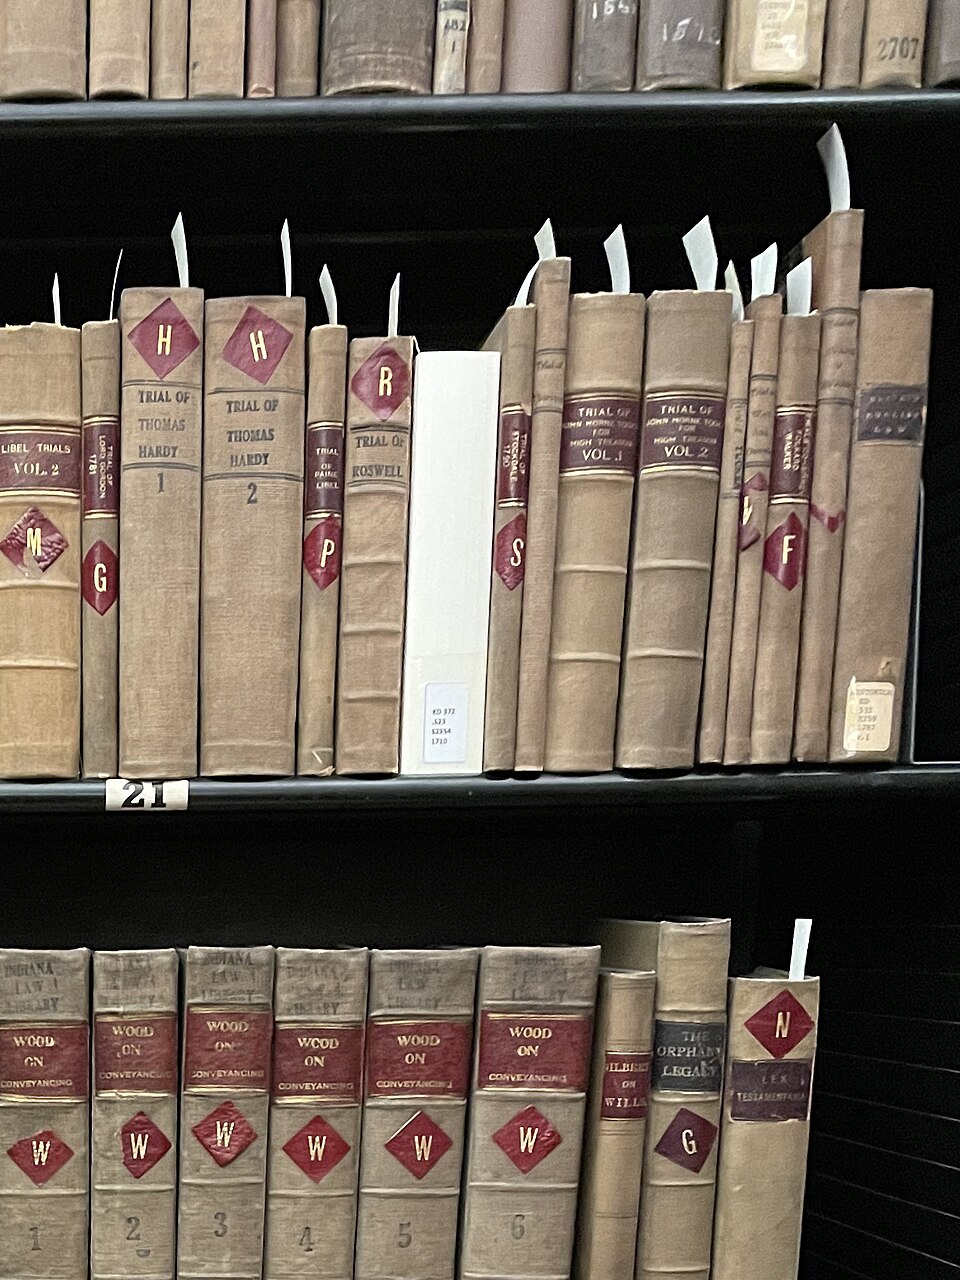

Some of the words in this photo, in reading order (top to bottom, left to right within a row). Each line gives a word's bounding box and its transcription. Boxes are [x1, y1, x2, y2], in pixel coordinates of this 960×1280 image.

[877, 37, 919, 60] 2707
[157, 324, 171, 356] H
[249, 328, 267, 362] H
[380, 366, 392, 396] R
[139, 391, 172, 403] TRIAL
[176, 391, 189, 403] OF
[227, 400, 260, 413] TRIAL
[264, 399, 279, 411] OF
[578, 408, 613, 417] TRIAL
[617, 408, 631, 416] OF
[662, 405, 696, 414] TRIAL
[700, 405, 713, 415] OF
[139, 419, 185, 432] THOMAS
[646, 418, 669, 426] JOHN
[227, 429, 274, 442] THOMAS
[356, 436, 388, 448] TRIAL
[393, 435, 406, 447] OF
[654, 436, 676, 444] HIGH
[2, 444, 28, 453] LIBEL
[37, 443, 71, 454] TRIALS
[519, 433, 528, 459] TRIAL
[571, 439, 592, 447] HIGH
[139, 446, 178, 458] HARDY
[316, 448, 339, 456] TRIAL
[510, 430, 520, 482] STOCKDALE
[665, 445, 695, 457] VOL
[698, 446, 709, 457] 2
[89, 454, 97, 474] 1781
[230, 453, 270, 467] HARDY
[15, 463, 47, 475] VOL.
[51, 464, 59, 475] 2
[352, 464, 403, 479] ROSWELL
[519, 462, 526, 475] OF
[107, 475, 113, 486] OF
[158, 473, 165, 494] 1
[316, 481, 339, 489] LIBEL
[247, 483, 258, 504] 2
[26, 526, 42, 555] M
[321, 538, 333, 567] P
[510, 540, 524, 567] S
[782, 534, 796, 563] F
[93, 563, 107, 592] G
[121, 780, 168, 808] 21
[112, 1025, 154, 1038] WOOD
[207, 1021, 248, 1032] WOOD
[775, 1012, 791, 1038] N
[509, 1027, 552, 1039] WOOD
[14, 1035, 55, 1047] WOOD
[215, 1042, 234, 1052] ON
[298, 1037, 339, 1049] WOOD
[397, 1035, 440, 1046] WOOD
[122, 1045, 140, 1056] ON
[517, 1046, 538, 1056] ON
[25, 1057, 43, 1067] ON
[304, 1056, 324, 1067] ON
[405, 1053, 425, 1064] ON
[100, 1071, 173, 1080] CONVEYANCING
[192, 1069, 264, 1078] CONVEYANCING
[488, 1073, 567, 1082] CONVEYANCING
[762, 1075, 788, 1085] LEX
[0, 1079, 73, 1088] CONVEYANCING
[278, 1082, 353, 1090] CONVEYANCING
[376, 1080, 452, 1089] CONVEYANCING
[216, 1121, 234, 1147] W
[520, 1126, 539, 1152] W
[130, 1133, 148, 1159] W
[307, 1135, 326, 1160] W
[414, 1135, 432, 1160] W
[680, 1130, 697, 1155] G
[31, 1140, 51, 1165] W
[127, 1217, 140, 1240] 2
[214, 1212, 227, 1237] 3
[510, 1215, 525, 1239] 6
[30, 1227, 40, 1250] 1
[299, 1226, 314, 1250] 4
[398, 1223, 412, 1247] 5
